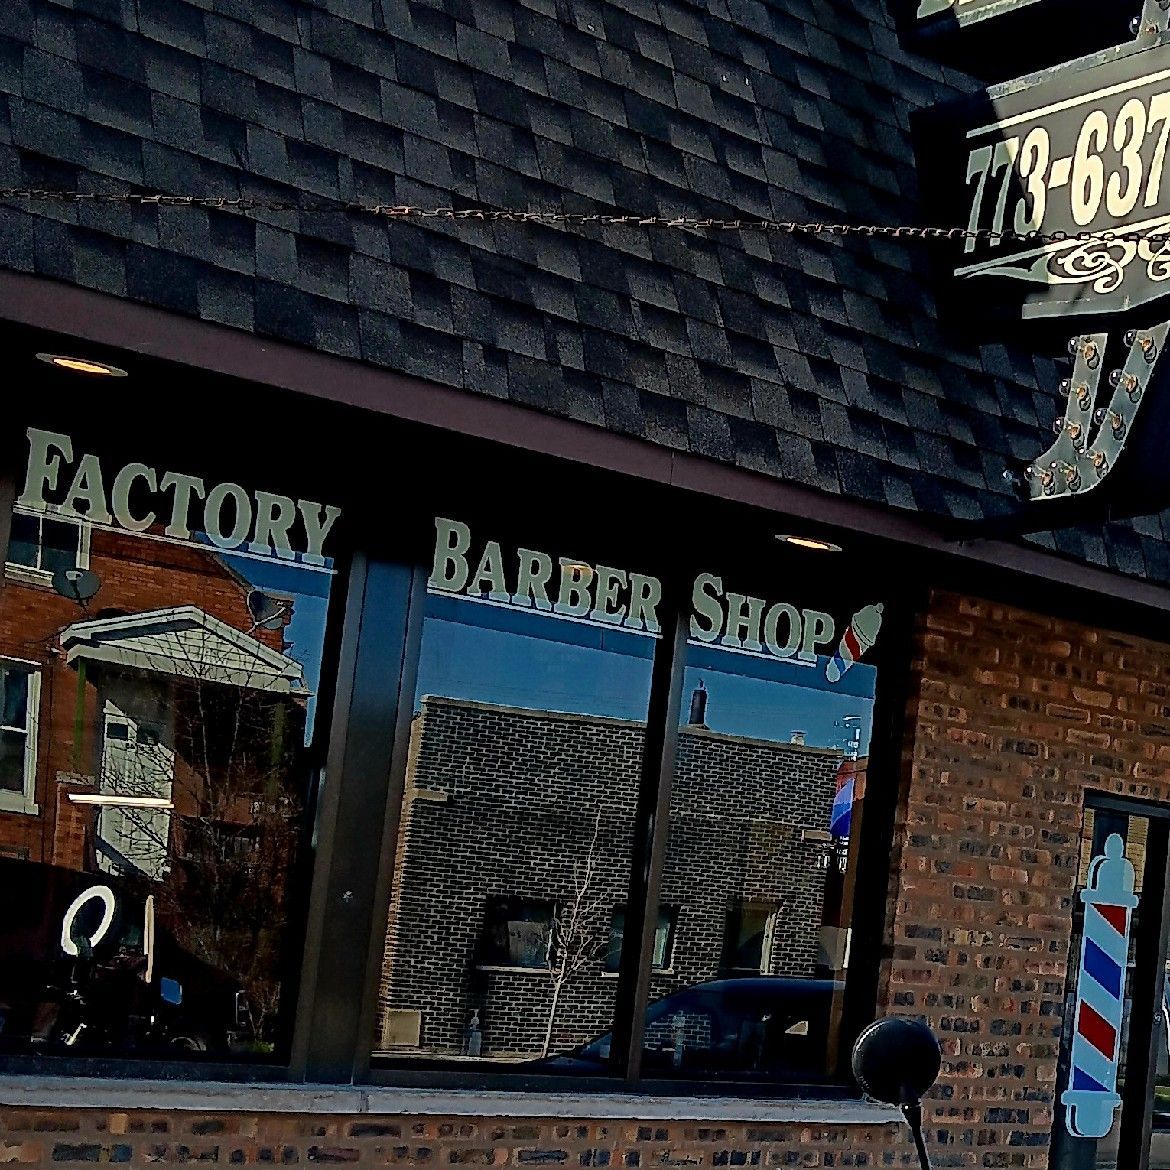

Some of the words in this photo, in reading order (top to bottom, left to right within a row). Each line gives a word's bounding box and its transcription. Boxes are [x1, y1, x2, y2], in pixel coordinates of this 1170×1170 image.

[17, 427, 341, 565] FACTORY
[427, 517, 662, 633] BARBER
[690, 573, 836, 662] SHOP
